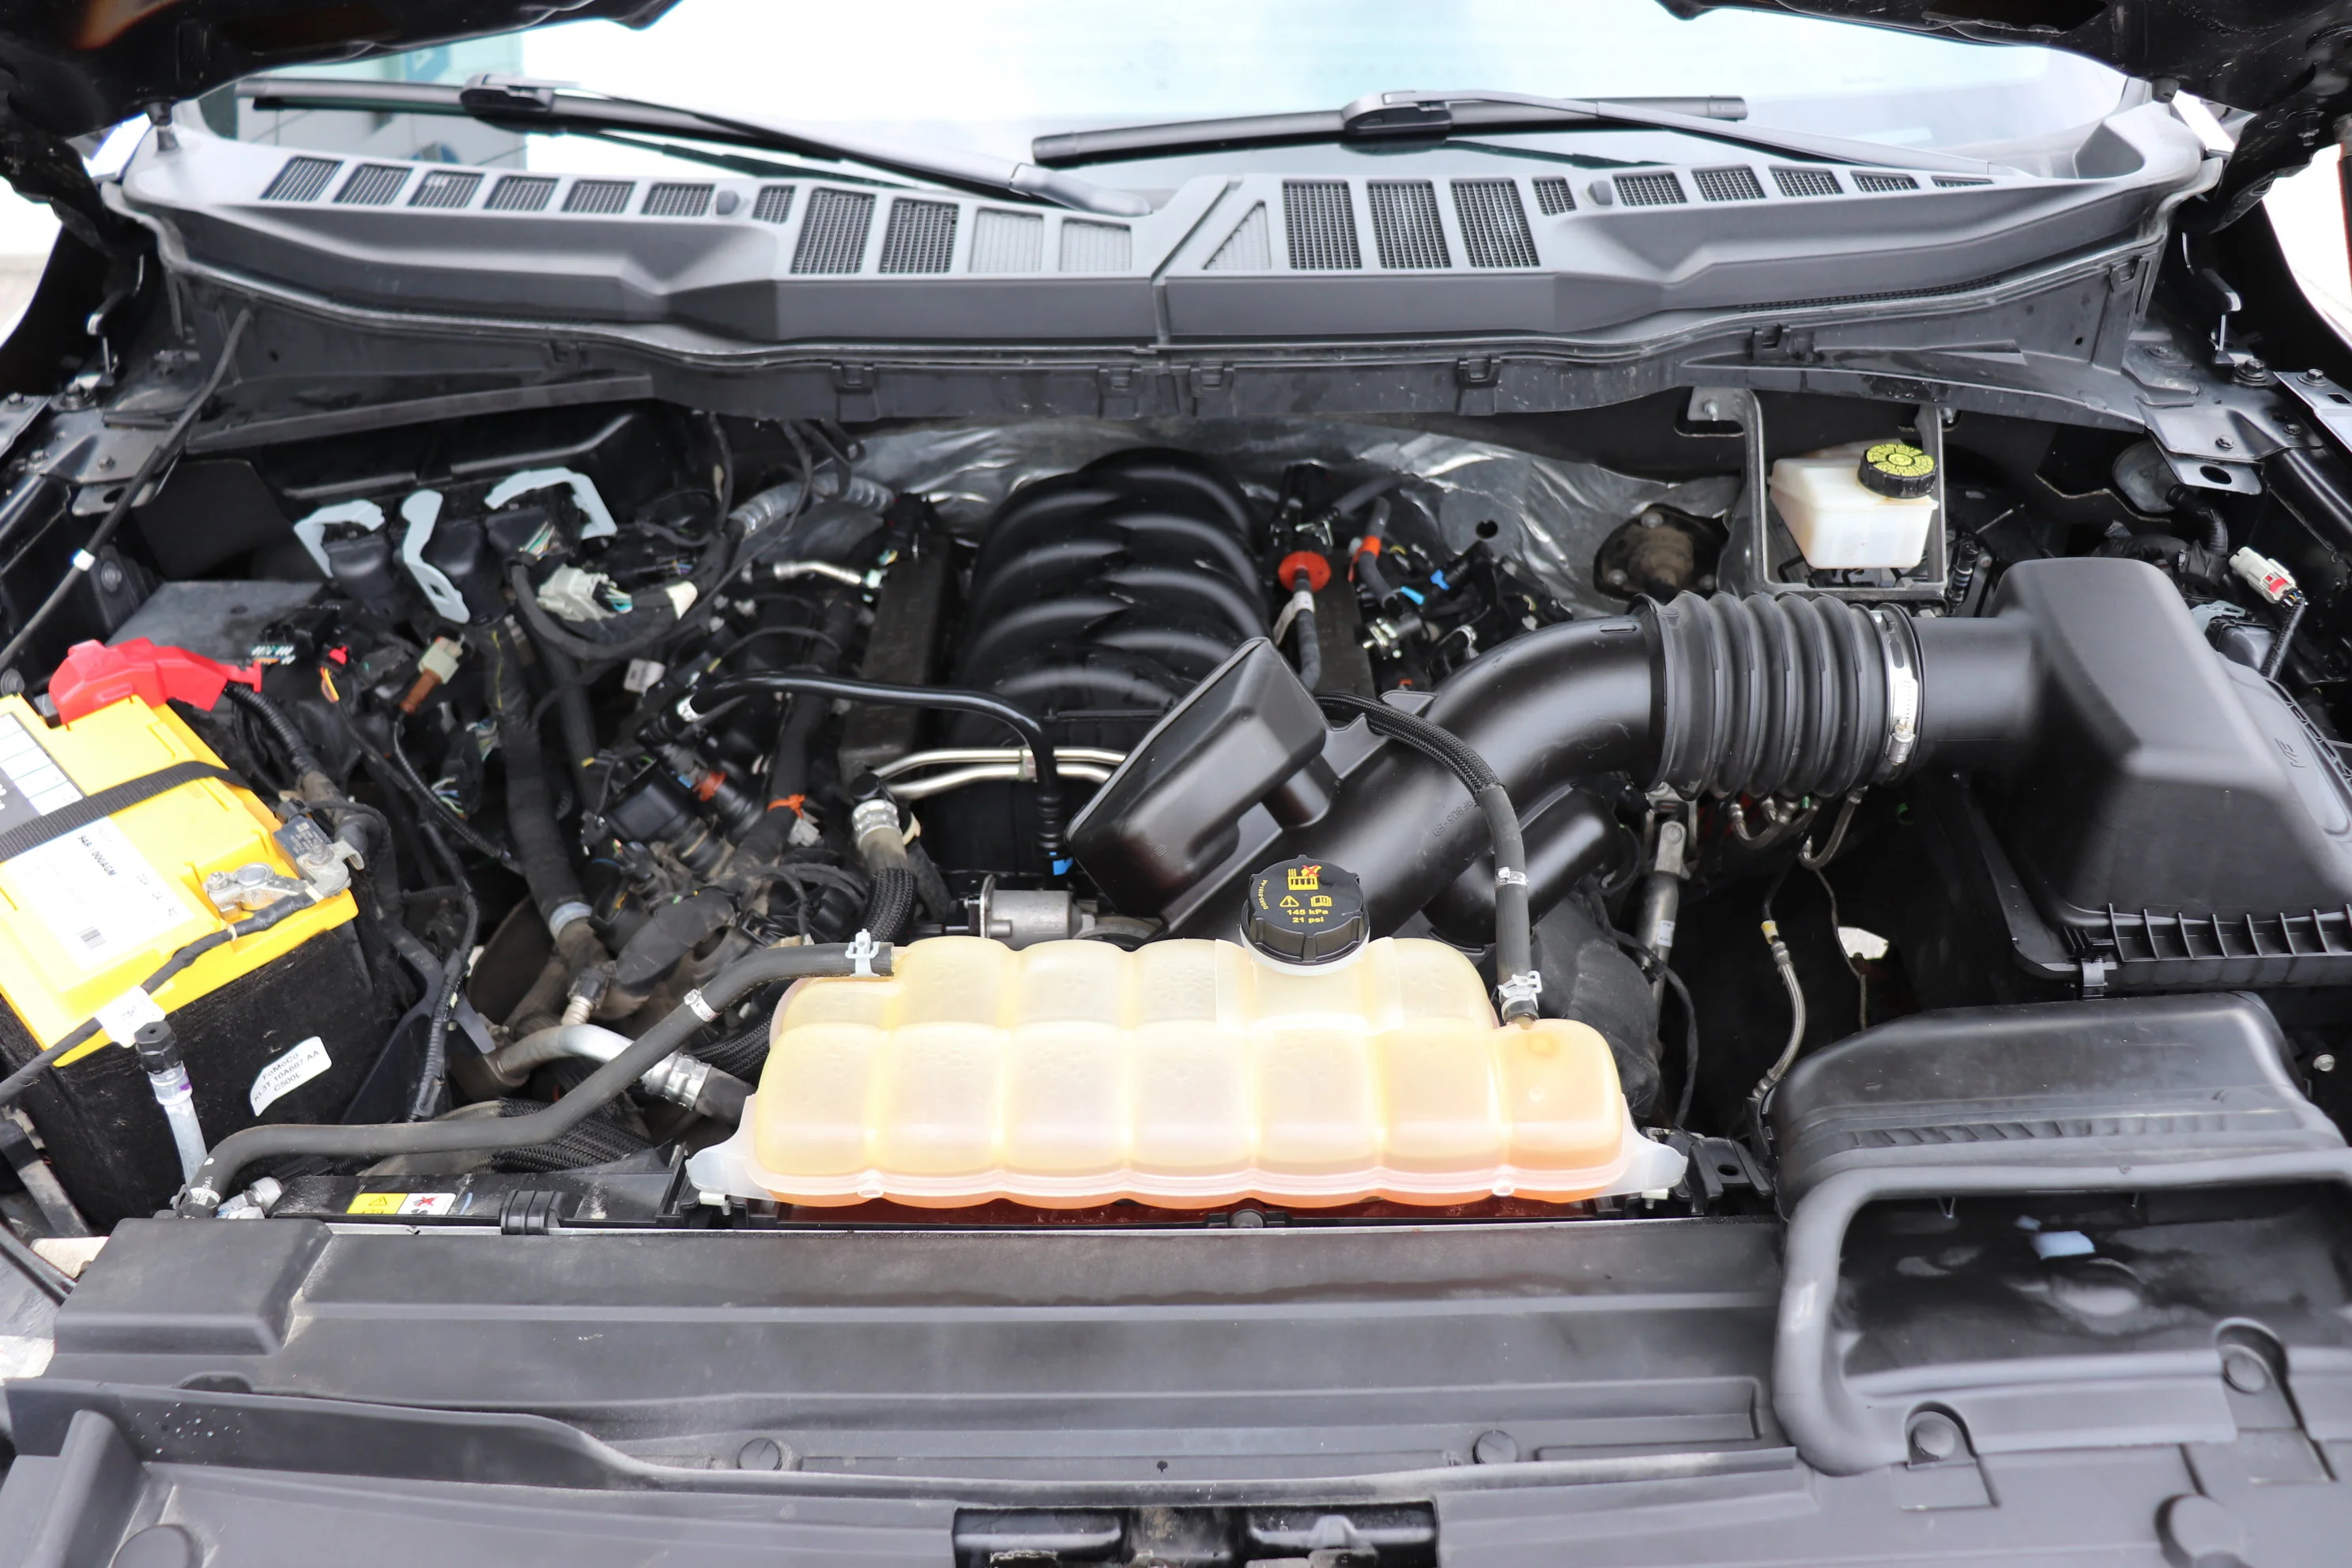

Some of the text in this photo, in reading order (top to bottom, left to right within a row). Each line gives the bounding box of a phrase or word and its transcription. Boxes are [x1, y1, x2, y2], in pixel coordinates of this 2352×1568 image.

[254, 1081, 271, 1102] KL3T
[307, 1051, 319, 1061] AA
[262, 1054, 299, 1080] FoMoCo
